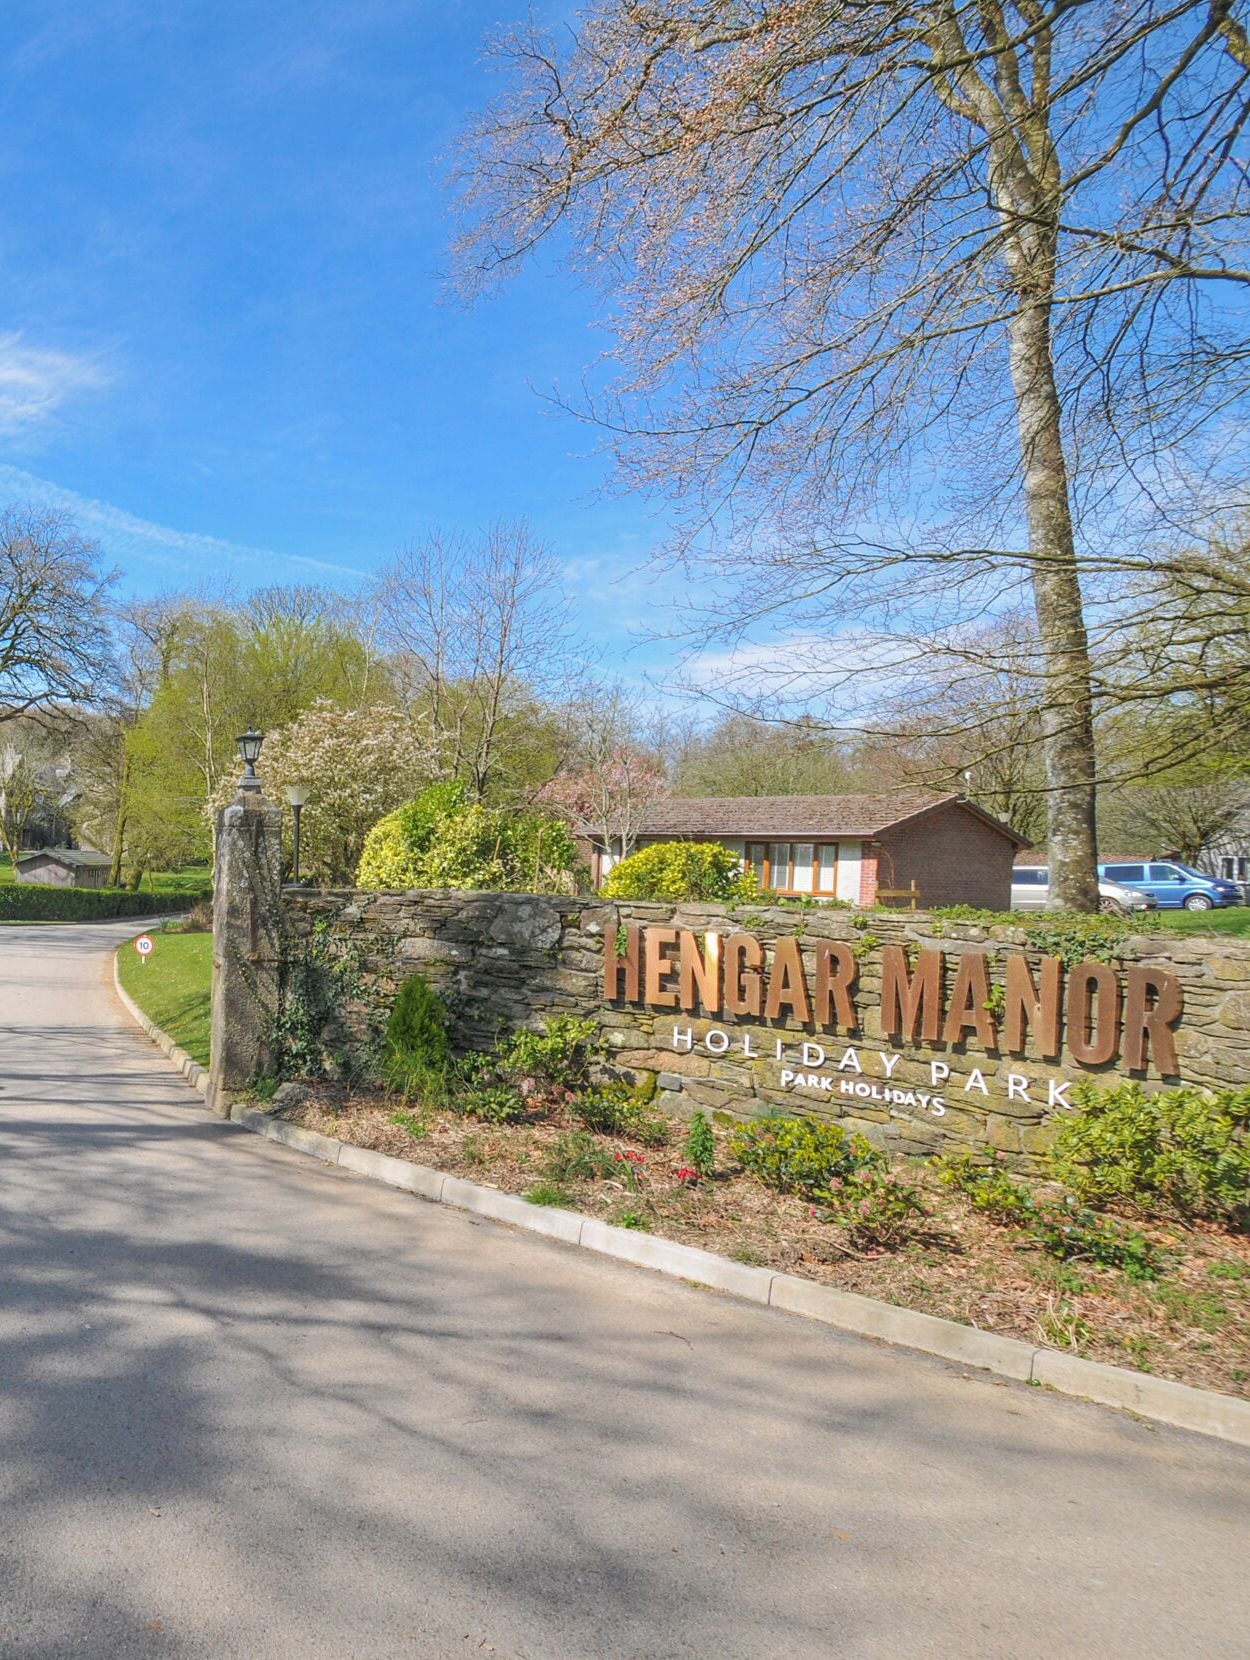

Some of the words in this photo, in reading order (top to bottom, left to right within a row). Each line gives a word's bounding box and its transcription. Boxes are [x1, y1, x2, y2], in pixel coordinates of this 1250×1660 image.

[139, 942, 149, 950] 10
[604, 922, 859, 1029] HENGAR
[881, 945, 1183, 1076] MANOR
[673, 1026, 899, 1077] HOLIDAY
[932, 1061, 1072, 1109] PARK
[780, 1070, 833, 1094] PARK
[841, 1080, 946, 1117] HOLIDAYS
